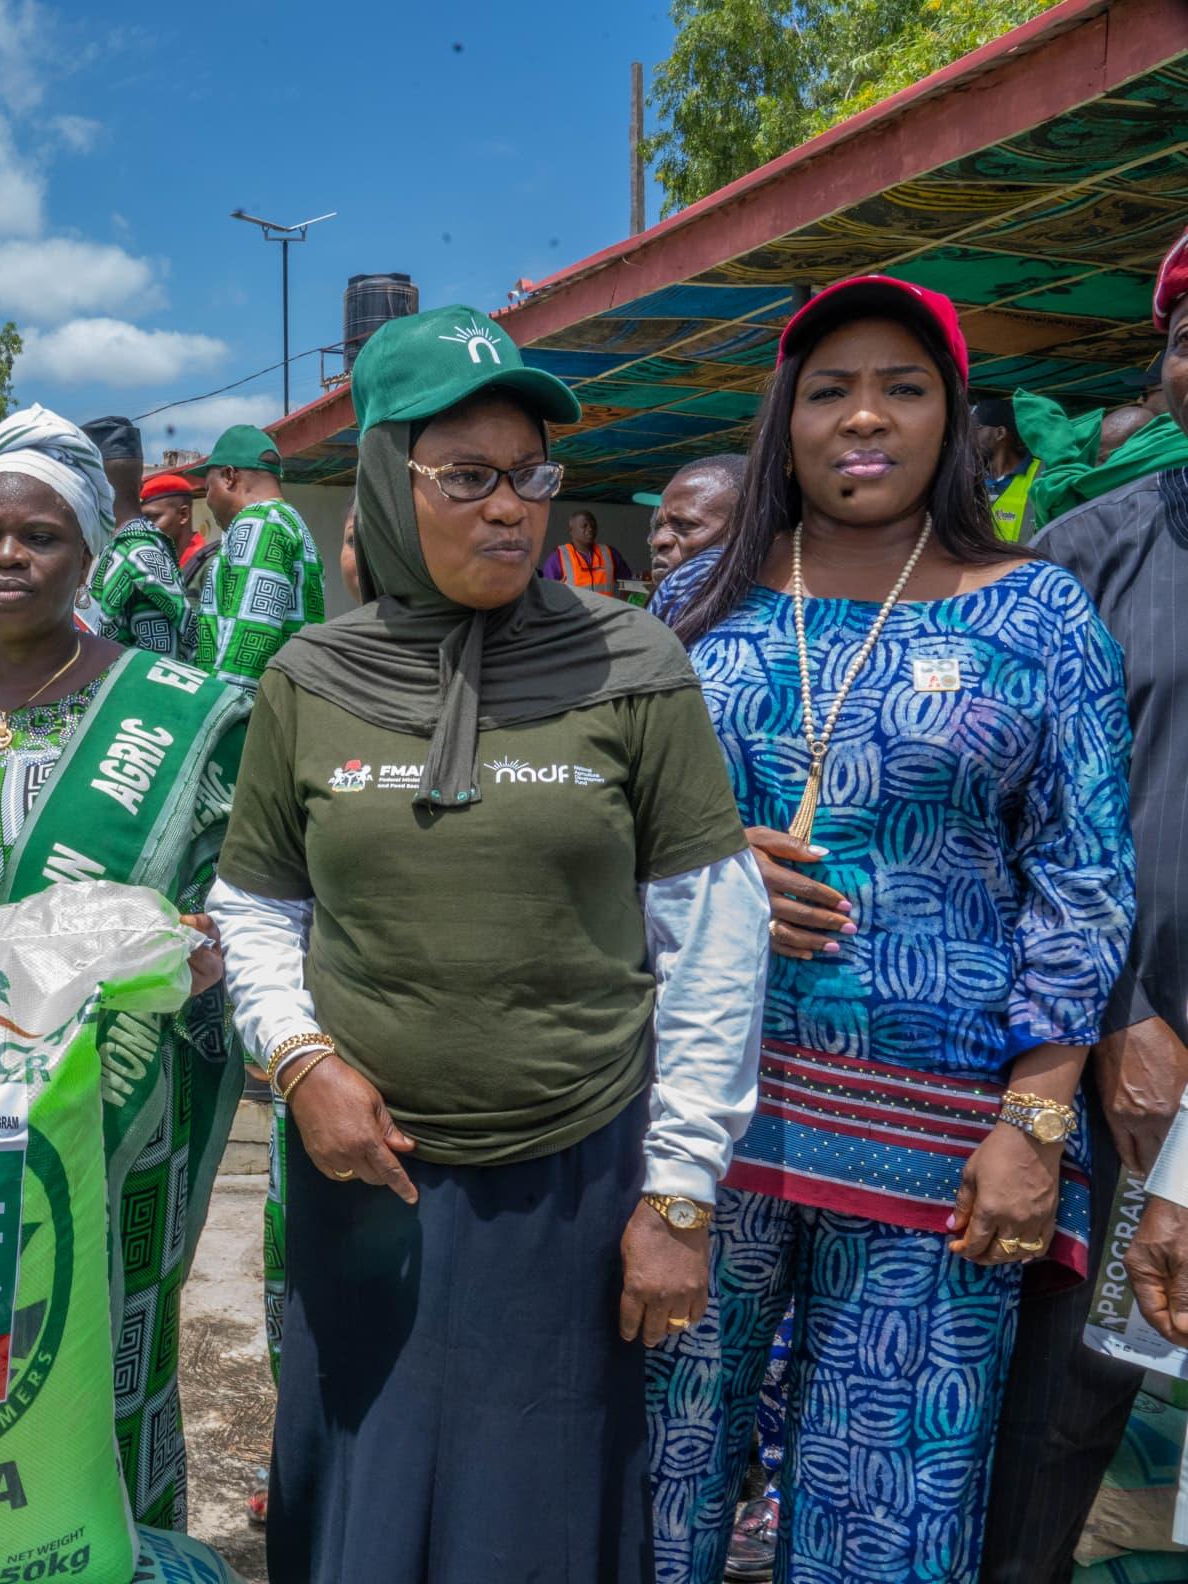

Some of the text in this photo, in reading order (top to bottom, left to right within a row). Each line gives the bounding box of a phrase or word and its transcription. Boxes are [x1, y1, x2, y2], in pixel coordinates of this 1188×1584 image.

[91, 718, 174, 816] AGRIC
[496, 764, 569, 783] nadf
[1096, 1170, 1148, 1317] PROGRAM
[7, 1525, 85, 1564] NET WEIGHT
